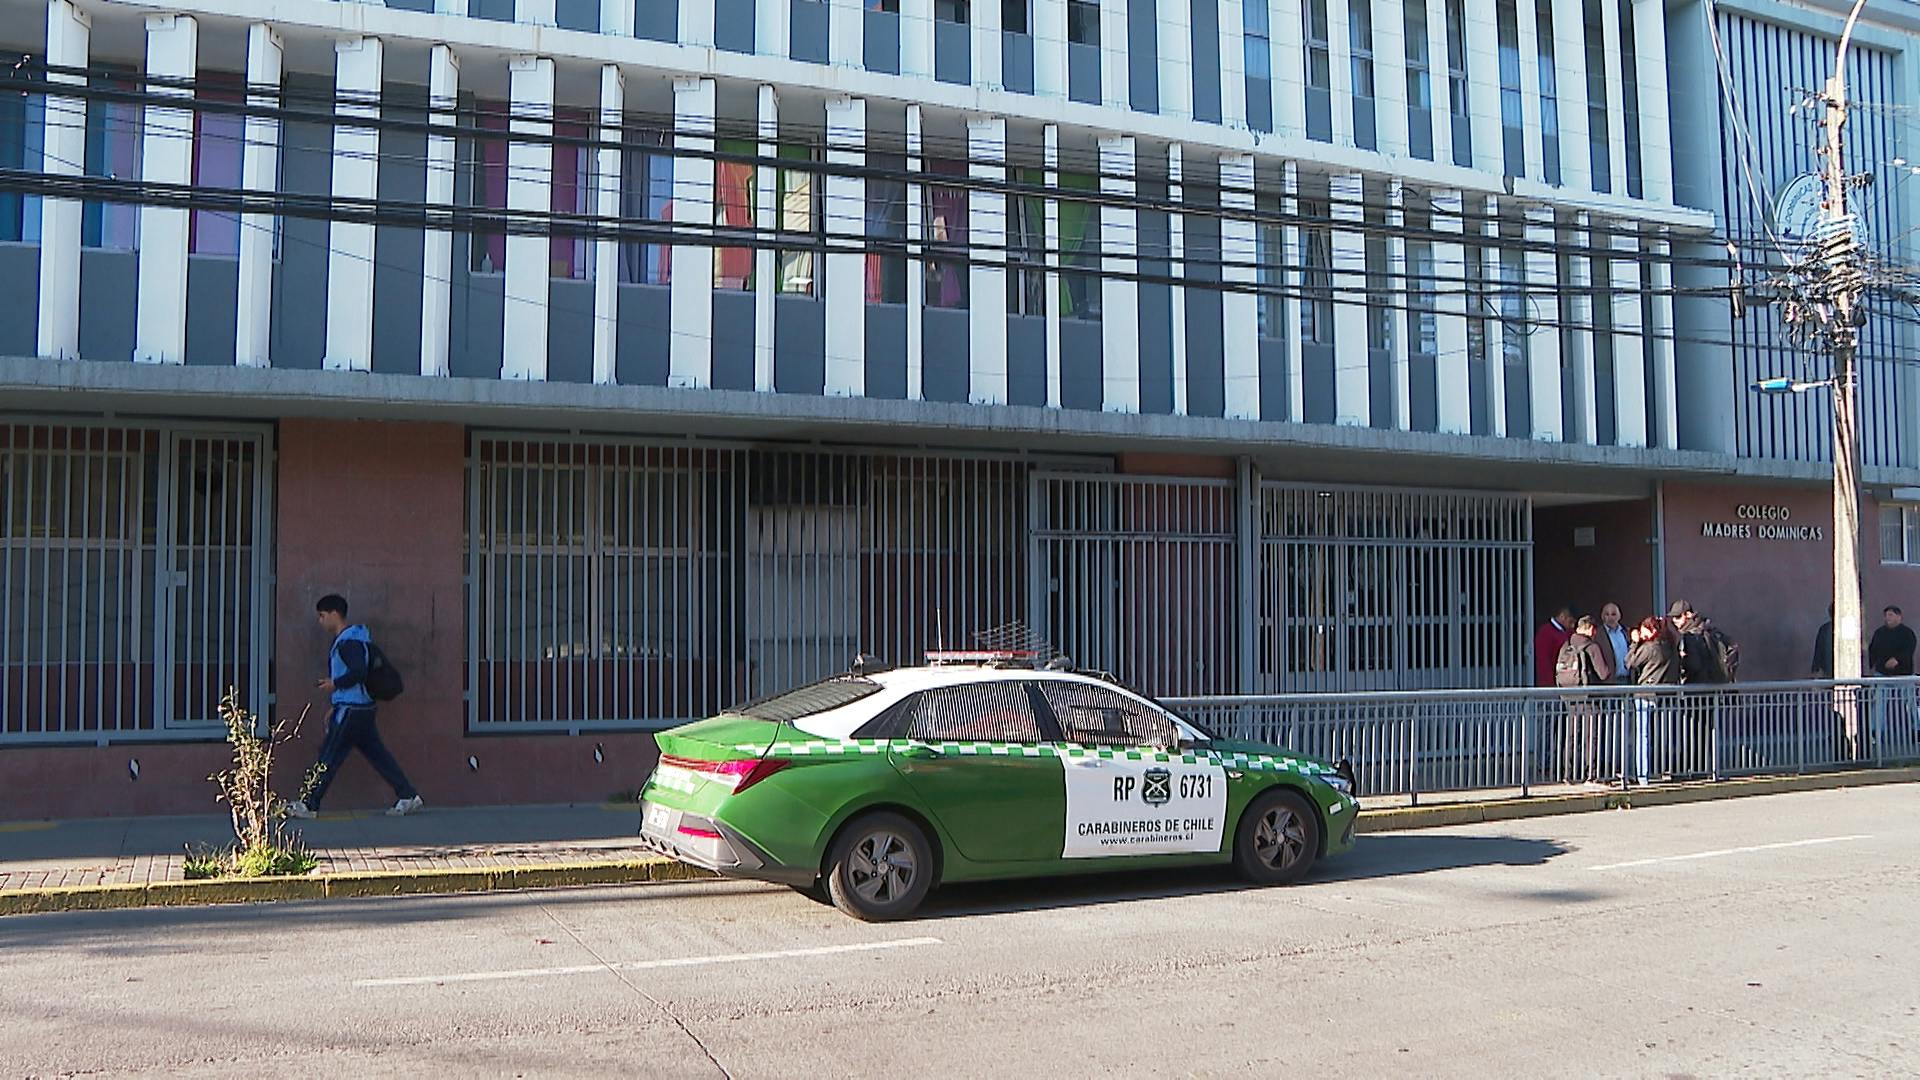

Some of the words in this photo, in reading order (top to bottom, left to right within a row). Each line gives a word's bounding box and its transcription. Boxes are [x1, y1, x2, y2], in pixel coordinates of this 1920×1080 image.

[1737, 505, 1790, 520] COLEGIO
[1702, 522, 1751, 538] MADRES
[1758, 525, 1823, 541] DOMINICAS
[1113, 776, 1135, 801] RP
[1180, 774, 1212, 798] 6731
[1078, 820, 1161, 836] CARABINEROS
[1165, 819, 1180, 832] DE
[1183, 817, 1214, 831] CHILE
